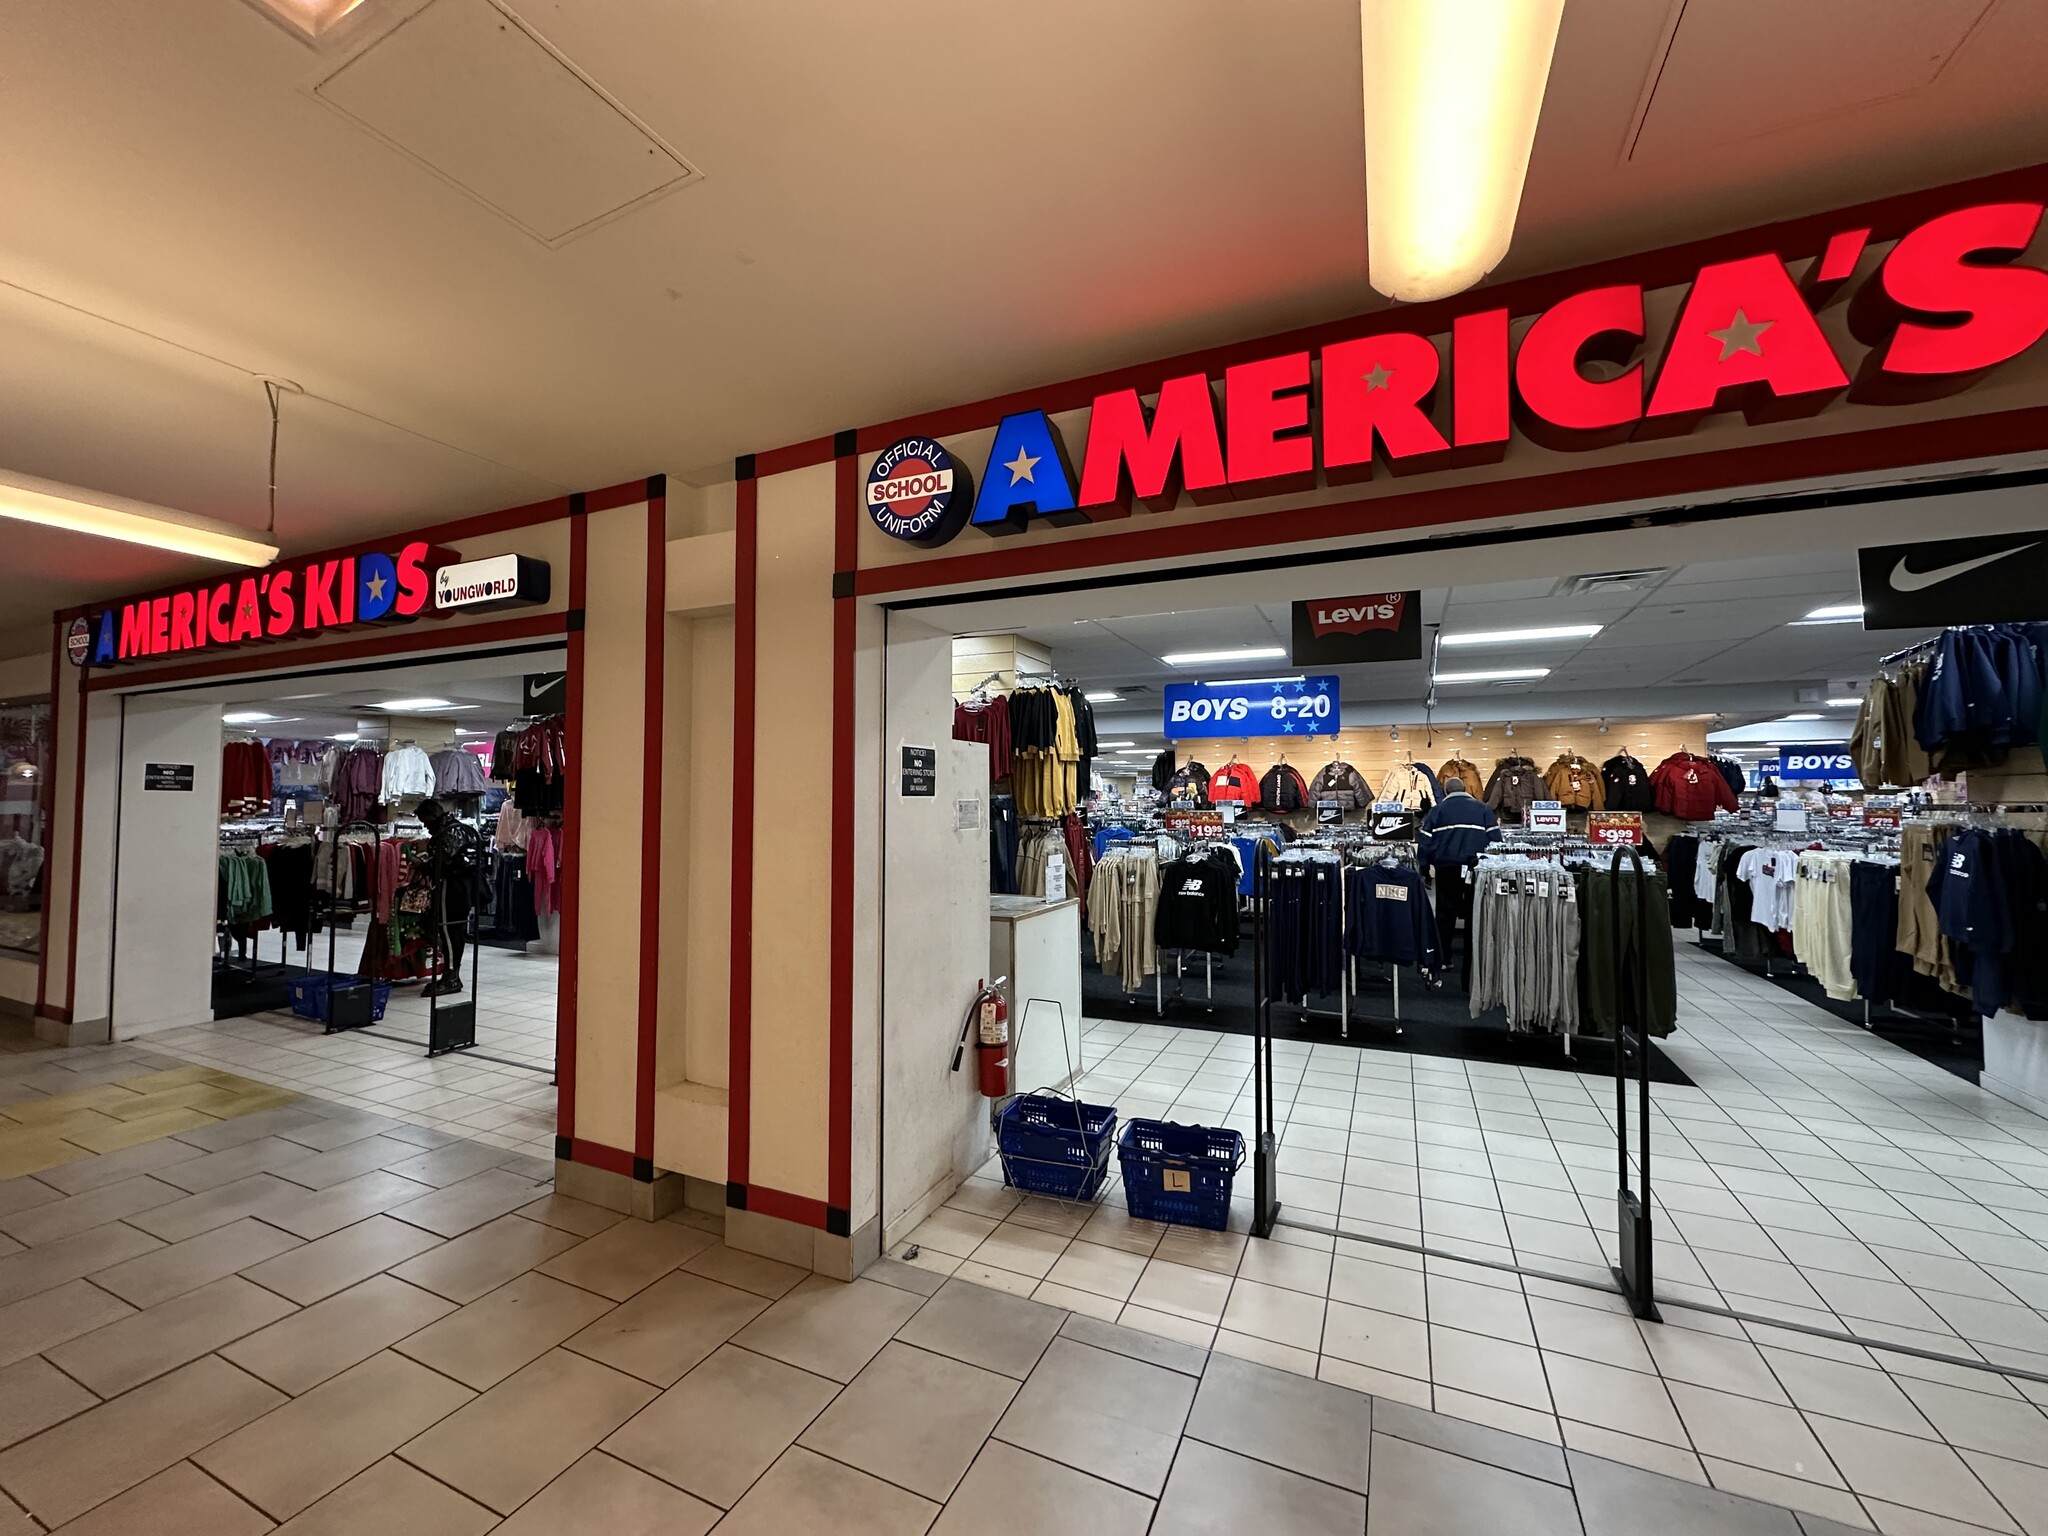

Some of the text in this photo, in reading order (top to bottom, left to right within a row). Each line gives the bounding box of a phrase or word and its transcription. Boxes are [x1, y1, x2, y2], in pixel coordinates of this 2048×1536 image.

[971, 203, 2048, 525] AMERICA'S
[876, 440, 942, 477] OFFICIAL
[873, 474, 947, 501] SCHOOL
[876, 499, 944, 534] UNIFORM
[440, 569, 449, 587] by
[438, 578, 516, 604] YOUNGWORLD
[95, 542, 429, 663] AMERICA'S KIDS
[1171, 694, 1331, 722] BOYS 8-20
[913, 760, 923, 768] NO
[1761, 764, 1780, 772] BOY
[1787, 755, 1852, 770] BOYS
[1374, 803, 1403, 812] 8-20
[1380, 816, 1404, 828] NIKE
[1378, 886, 1406, 899] NIKE
[1172, 1172, 1183, 1188] L
